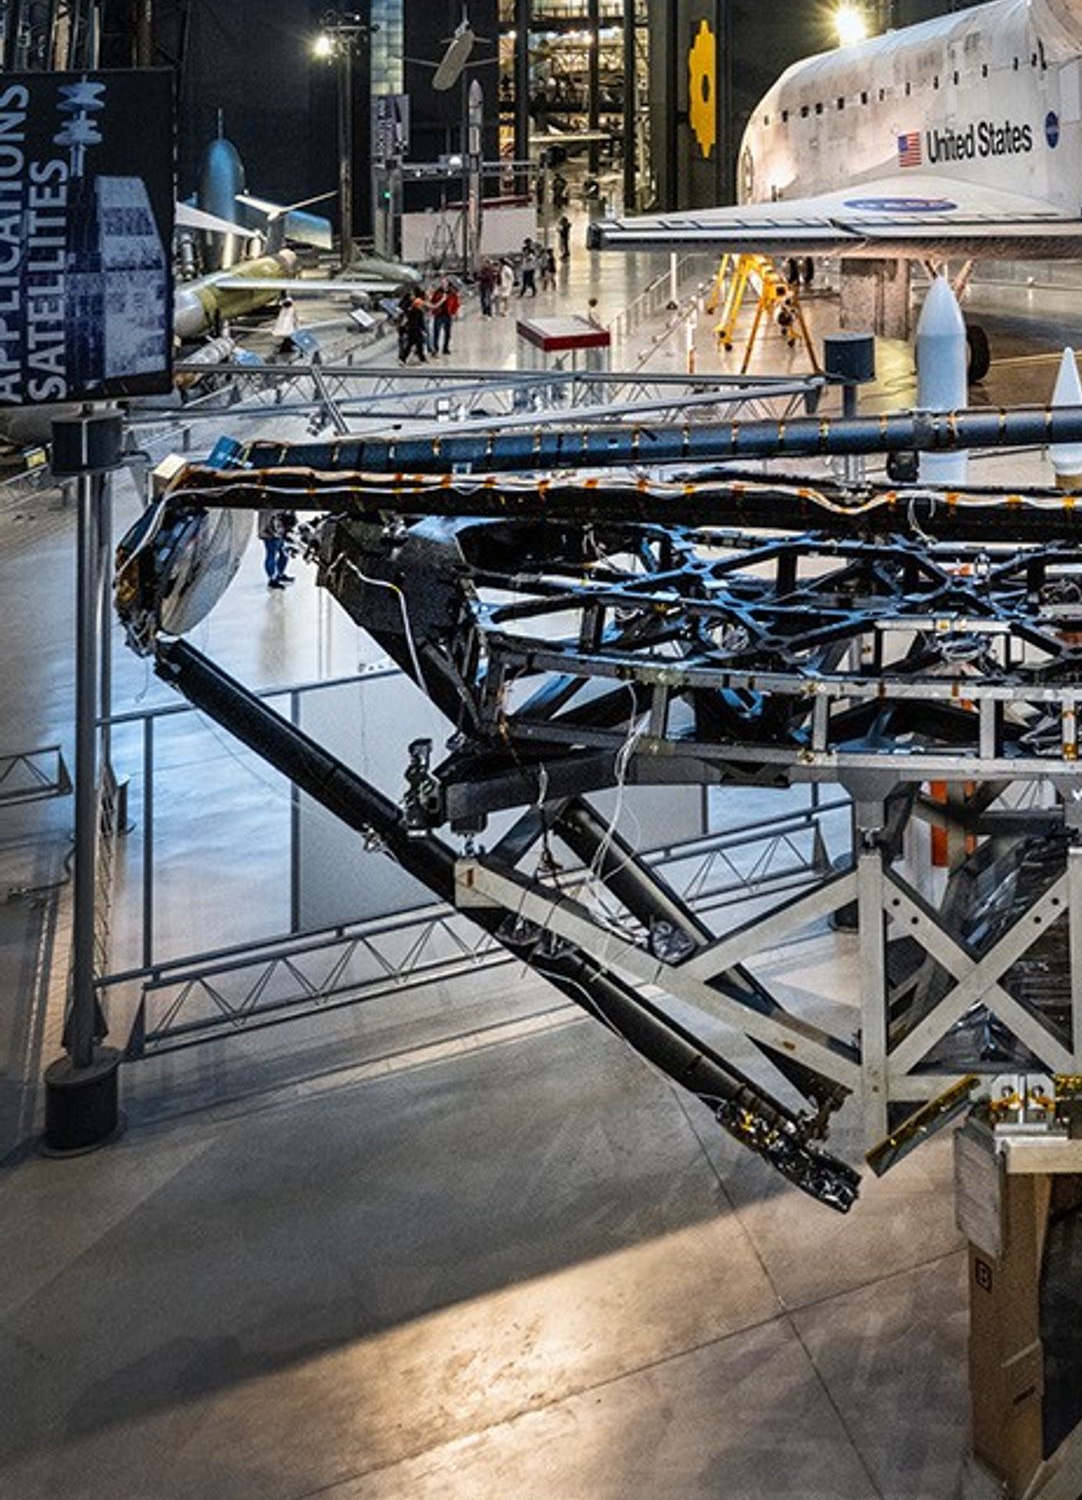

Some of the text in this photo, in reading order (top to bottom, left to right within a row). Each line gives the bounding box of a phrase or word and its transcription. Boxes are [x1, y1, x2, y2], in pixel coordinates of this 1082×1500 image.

[927, 121, 1033, 164] United States
[28, 159, 68, 401] SATELLITES
